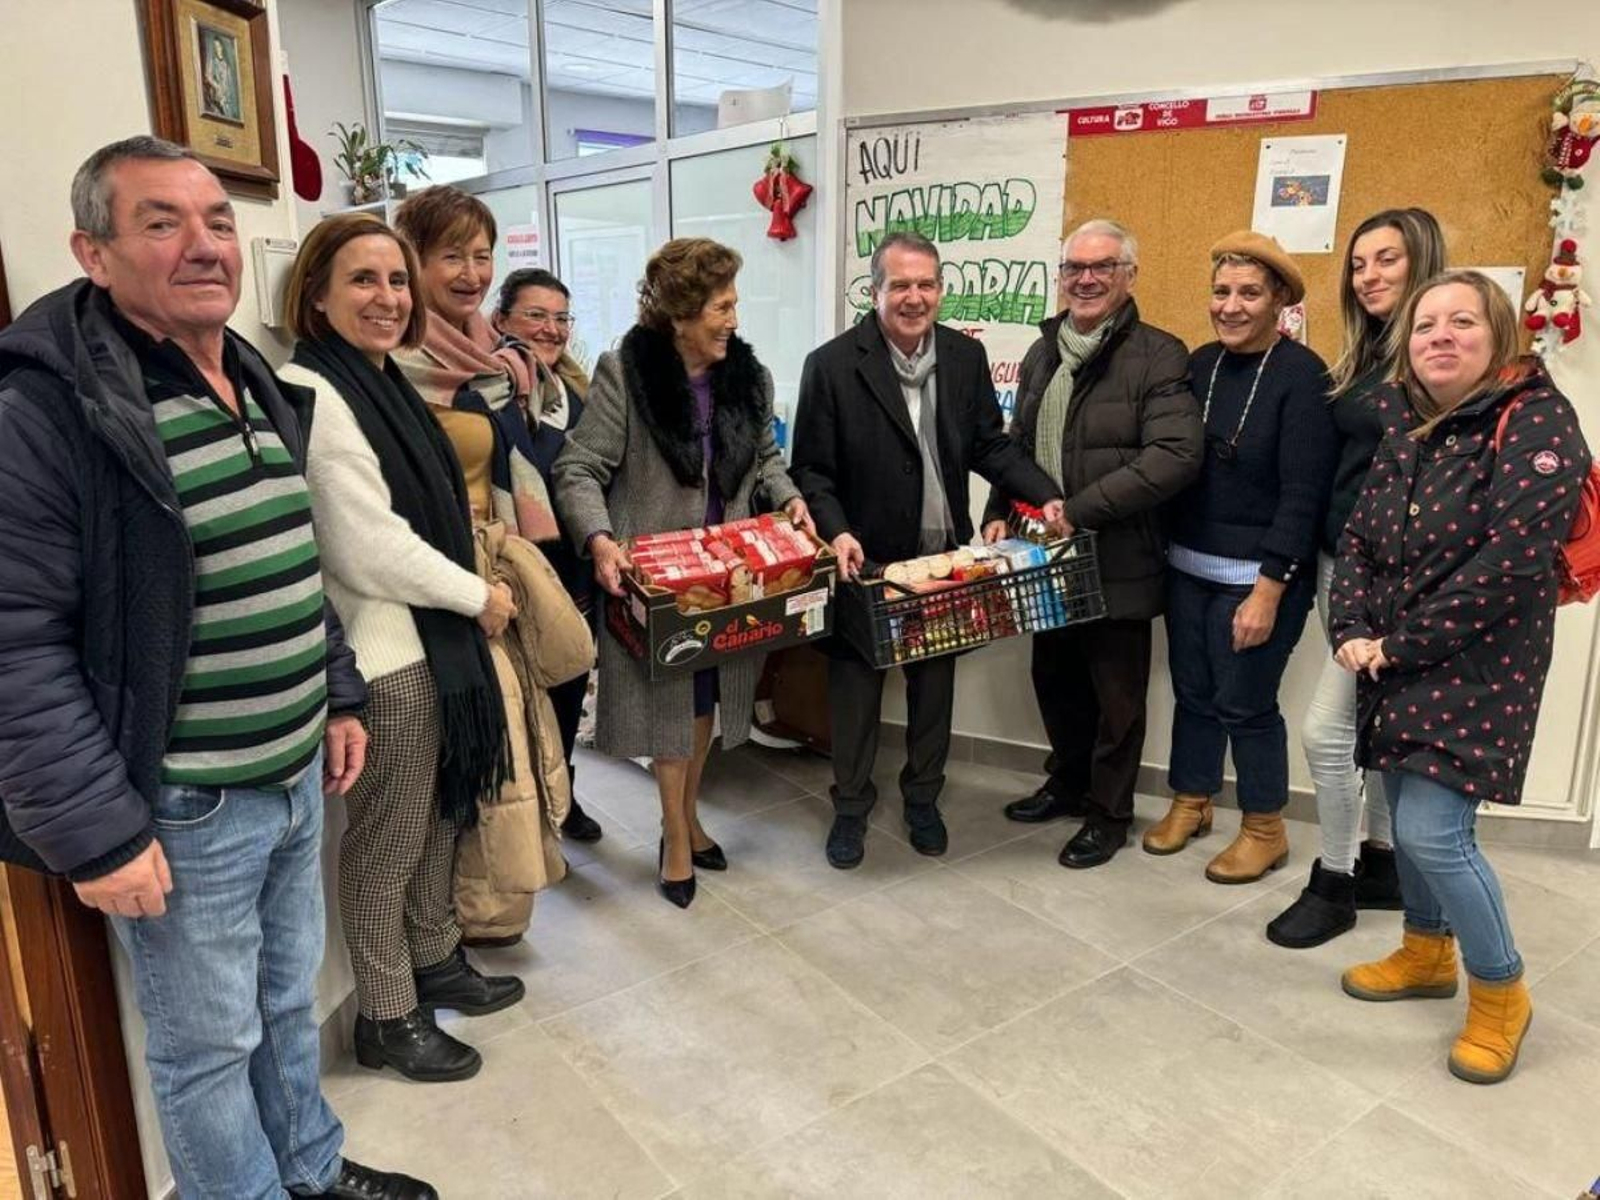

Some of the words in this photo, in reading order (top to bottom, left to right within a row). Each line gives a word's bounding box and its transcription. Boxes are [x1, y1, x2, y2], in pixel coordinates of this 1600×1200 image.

[1077, 114, 1110, 125] CULTURA
[1157, 117, 1179, 127] VIGO
[855, 178, 1037, 258] NAVIDAD
